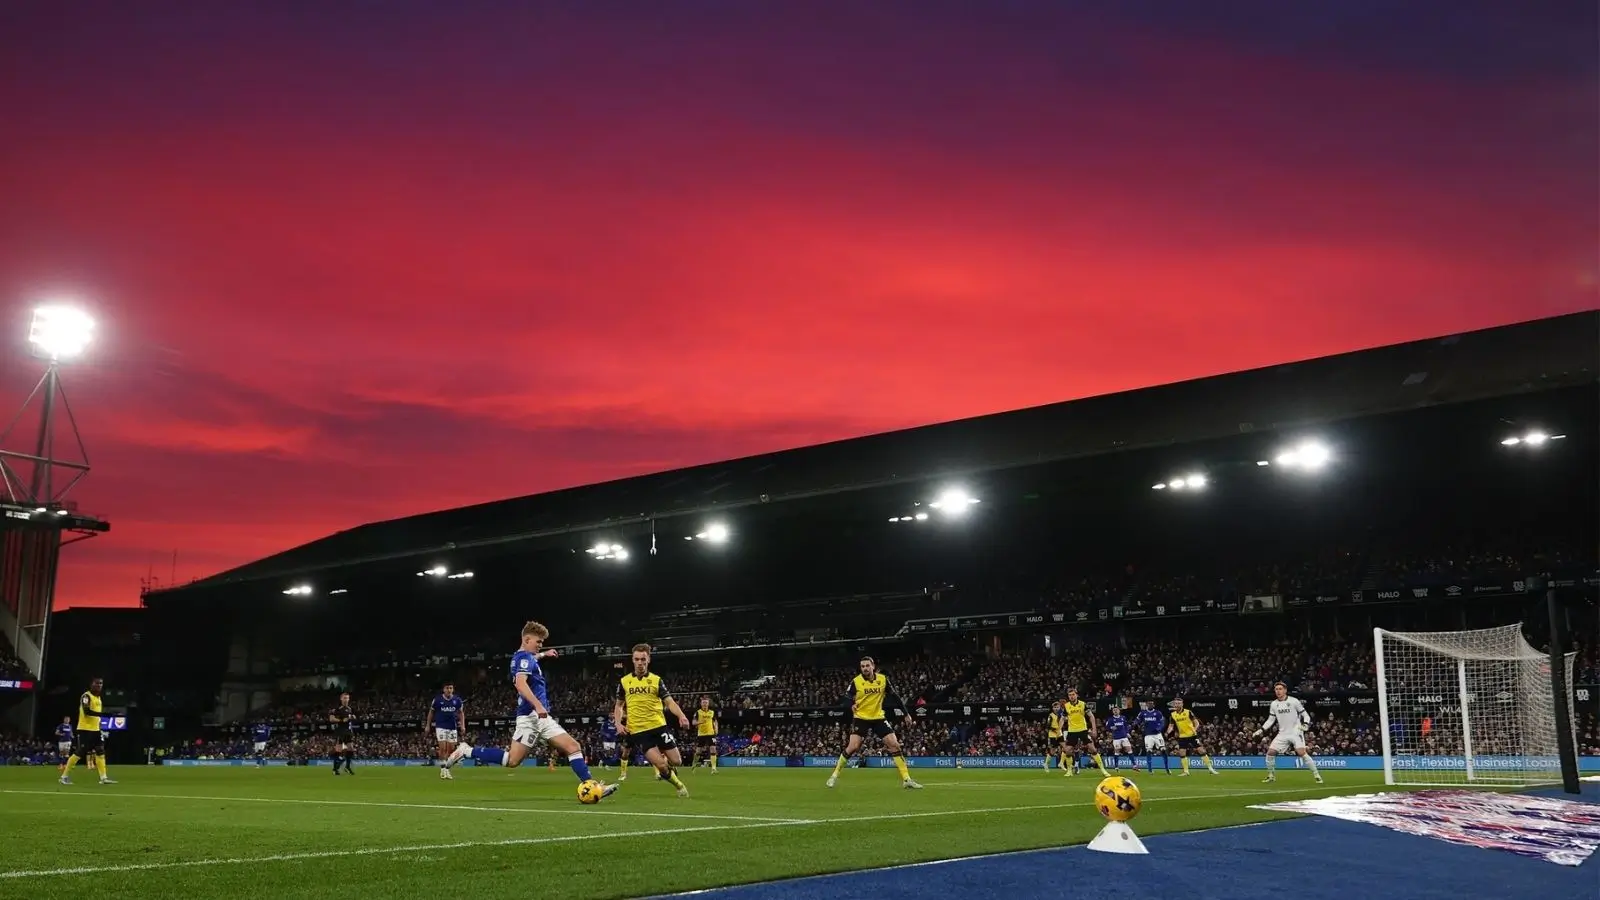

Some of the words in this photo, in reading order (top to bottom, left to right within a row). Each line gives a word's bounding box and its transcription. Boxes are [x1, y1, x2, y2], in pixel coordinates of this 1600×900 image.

[1377, 591, 1400, 599] HALO
[1026, 615, 1044, 623] HALO
[629, 686, 651, 695] BAXI
[1417, 694, 1442, 703] HALO
[935, 758, 953, 767] Fast,
[986, 757, 1018, 766] Business
[1021, 758, 1044, 766] Loans
[1391, 758, 1419, 768] Fast,
[1421, 757, 1464, 767] Flexible
